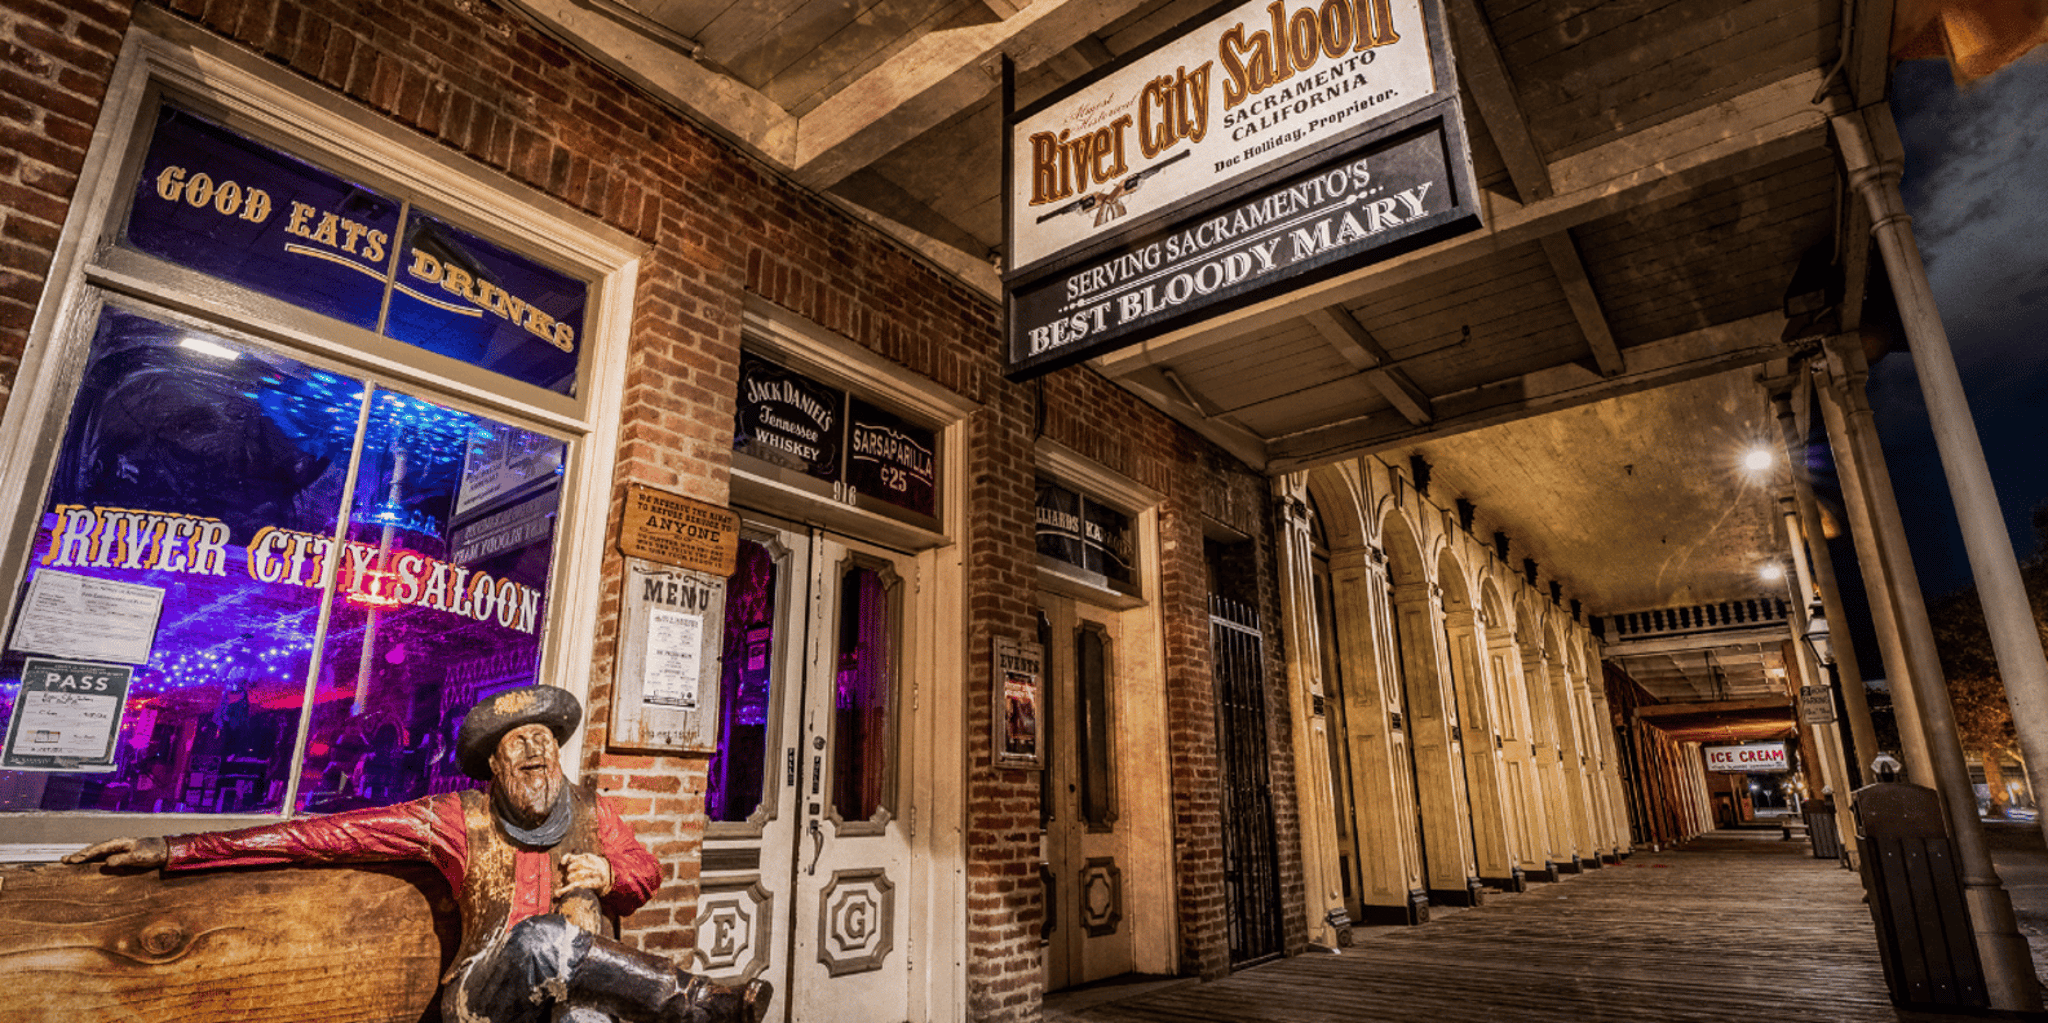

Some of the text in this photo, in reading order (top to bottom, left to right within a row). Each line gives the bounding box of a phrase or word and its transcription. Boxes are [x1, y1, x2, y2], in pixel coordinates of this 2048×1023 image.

[1029, 0, 1400, 206] River City Saloon
[1223, 50, 1376, 129] SACRAMENTO
[1231, 73, 1368, 142] CALIFORNIA
[1214, 155, 1241, 173] Doc
[1308, 89, 1399, 133] Proprietor.
[1066, 159, 1370, 301] SERVING SACRAMENTO'S
[156, 165, 575, 353] GOOD EATS DRINKS
[1028, 181, 1433, 357] BEST BLOODY MARY
[747, 378, 833, 432] JACK DANIEL'S
[759, 404, 819, 443] Tennessee
[755, 426, 820, 461] WHISKEY
[853, 428, 933, 480] SARSAPARILLA
[880, 463, 907, 492] ¢25
[638, 502, 732, 532] TO REFUSE SERVICE TO
[654, 497, 691, 513] RESERVE
[692, 507, 708, 518] THE
[1036, 506, 1079, 533] LLIARDS
[646, 515, 720, 542] ANYONE
[42, 504, 541, 635] RIVER CITY SALOON
[643, 578, 710, 611] MENU
[45, 672, 109, 691] PASS
[1000, 654, 1039, 673] EVENTS
[1711, 750, 1785, 763] ICE CREAM
[711, 913, 736, 957] E
[844, 901, 866, 939] G
